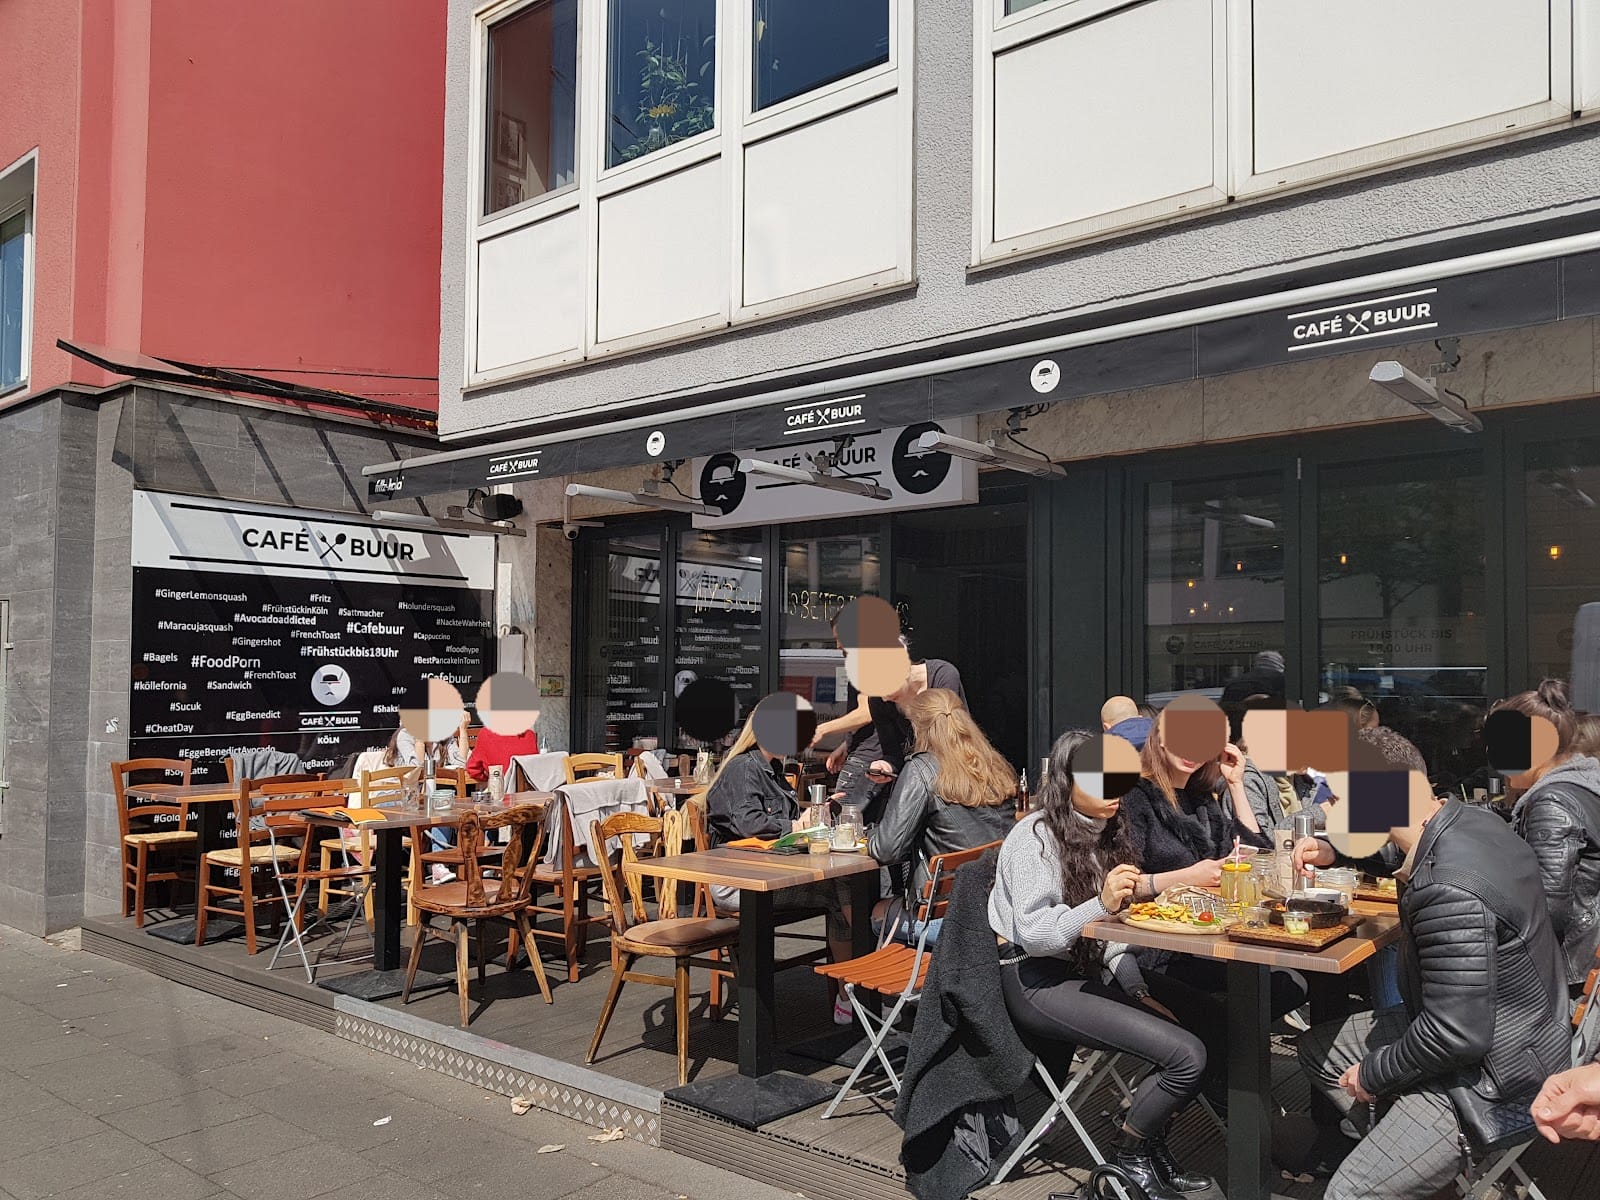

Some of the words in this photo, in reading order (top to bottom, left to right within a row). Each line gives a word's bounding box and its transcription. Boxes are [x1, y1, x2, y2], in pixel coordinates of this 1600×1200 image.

[1293, 315, 1343, 340] CAFÉ
[1374, 302, 1431, 326] BUUR
[787, 411, 815, 426] CAFÉ
[831, 404, 862, 420] BUUR
[489, 462, 508, 473] CAFÉ
[518, 458, 538, 470] BUUR
[242, 528, 309, 552] CAFÉ
[350, 538, 414, 561] BUUR
[155, 589, 248, 602] #GingerLemonsquash
[310, 594, 332, 603] #Fritz
[338, 608, 385, 618] #Sattmacher
[234, 614, 317, 626] #Avocadoaddicted
[157, 621, 234, 634] #Maracujasquash
[346, 622, 405, 636] #Cafebuur
[290, 631, 341, 641] #FrenchToast
[232, 637, 282, 648] #Gingershot
[143, 652, 179, 664] #Bagels
[300, 646, 400, 658] #Frühstückbis18Uhr
[191, 655, 261, 669] #FoodPorn
[244, 670, 297, 680] #FrenchToast
[207, 680, 252, 690] #Sandwich
[169, 702, 202, 712] #Sucuk
[225, 711, 281, 721] #EggBenedict
[301, 716, 324, 726] CAFÉ
[335, 716, 359, 726] BUUR
[145, 723, 194, 735] #CheatDay
[317, 734, 340, 745] KÖLN
